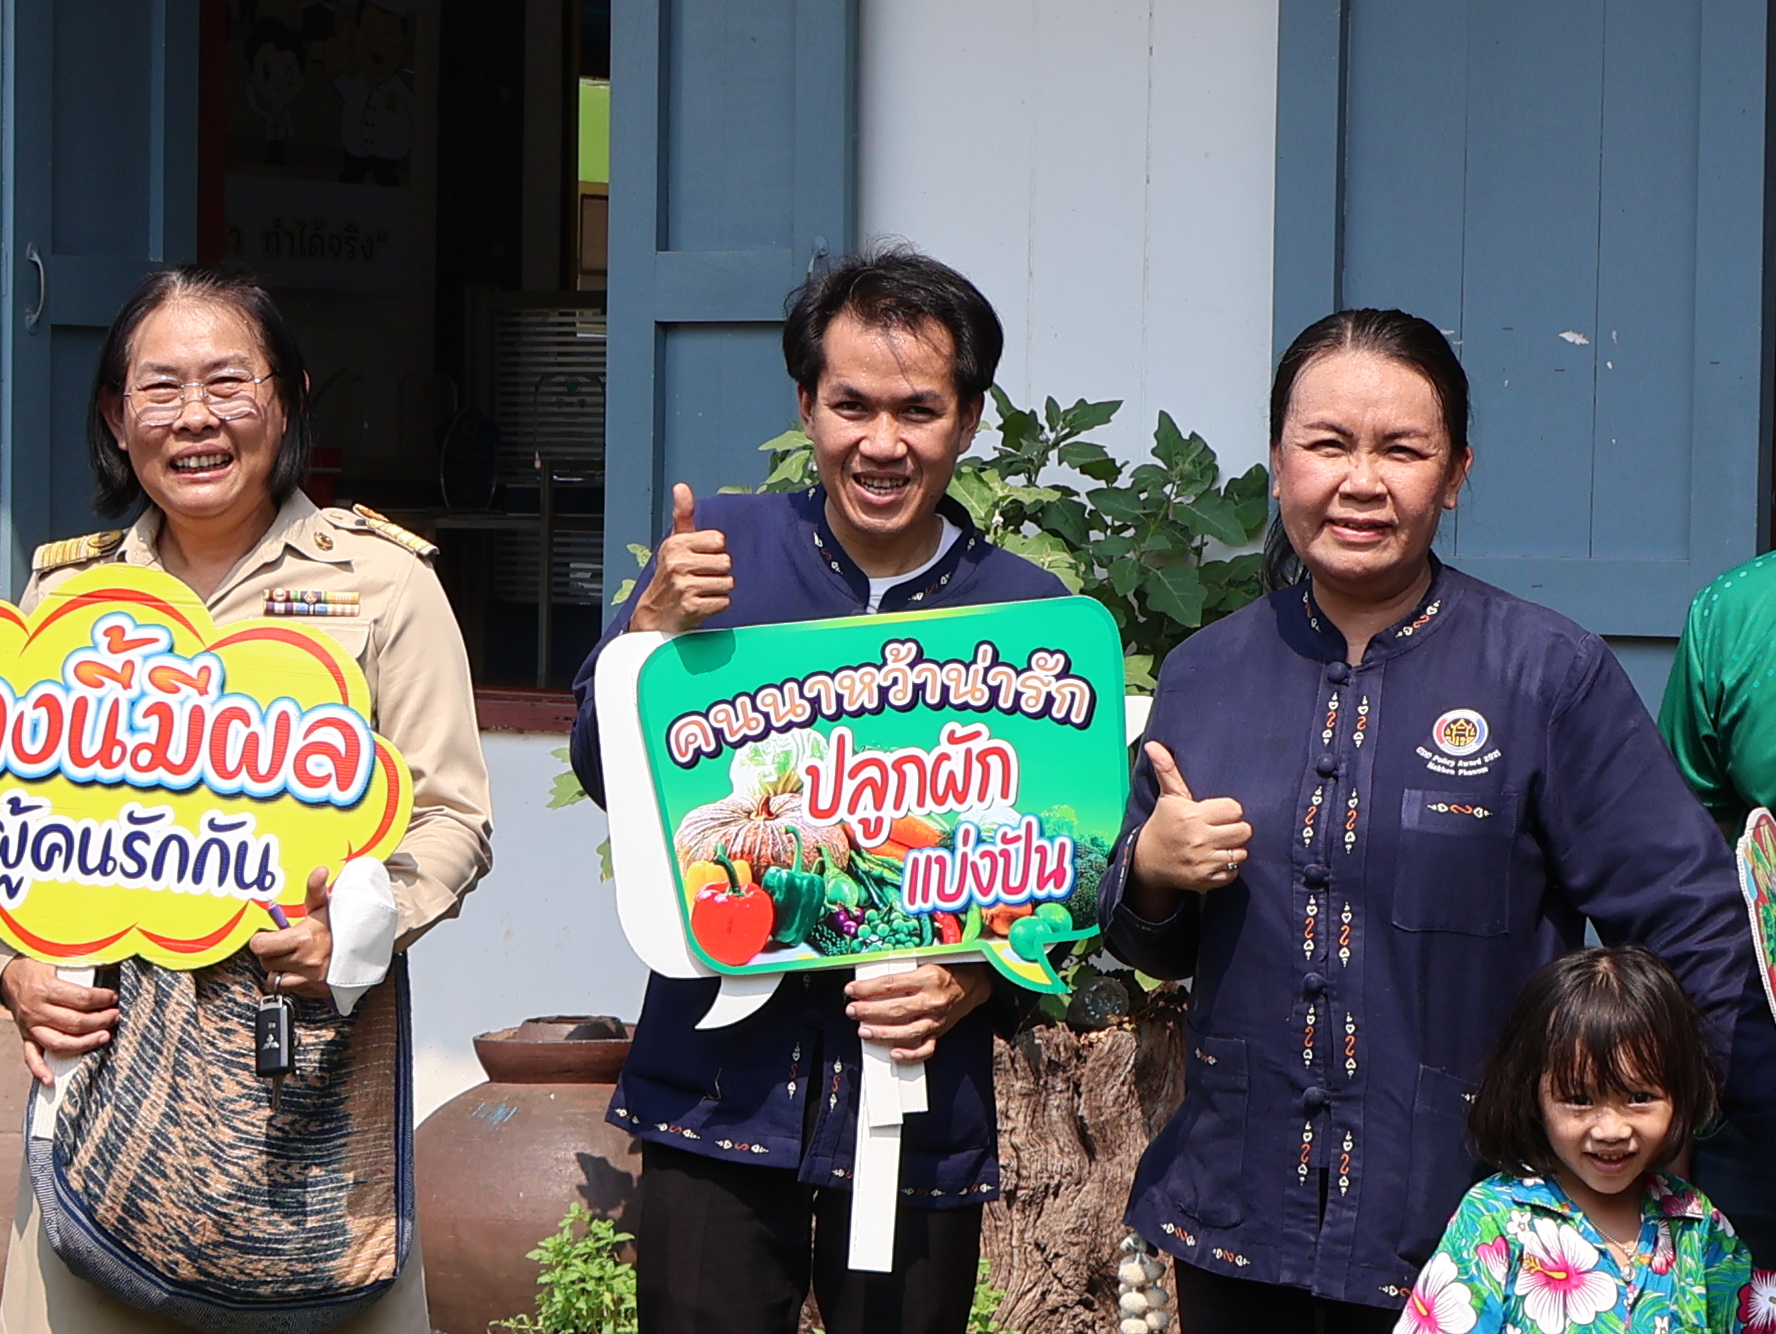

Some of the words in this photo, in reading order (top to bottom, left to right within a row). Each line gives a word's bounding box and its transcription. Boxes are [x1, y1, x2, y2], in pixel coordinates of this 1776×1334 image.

[669, 641, 1091, 763] คนนาหว้าน่ารัก
[806, 725, 1016, 845] ปลูกผัก
[905, 820, 1072, 909] แบ่งปัน
